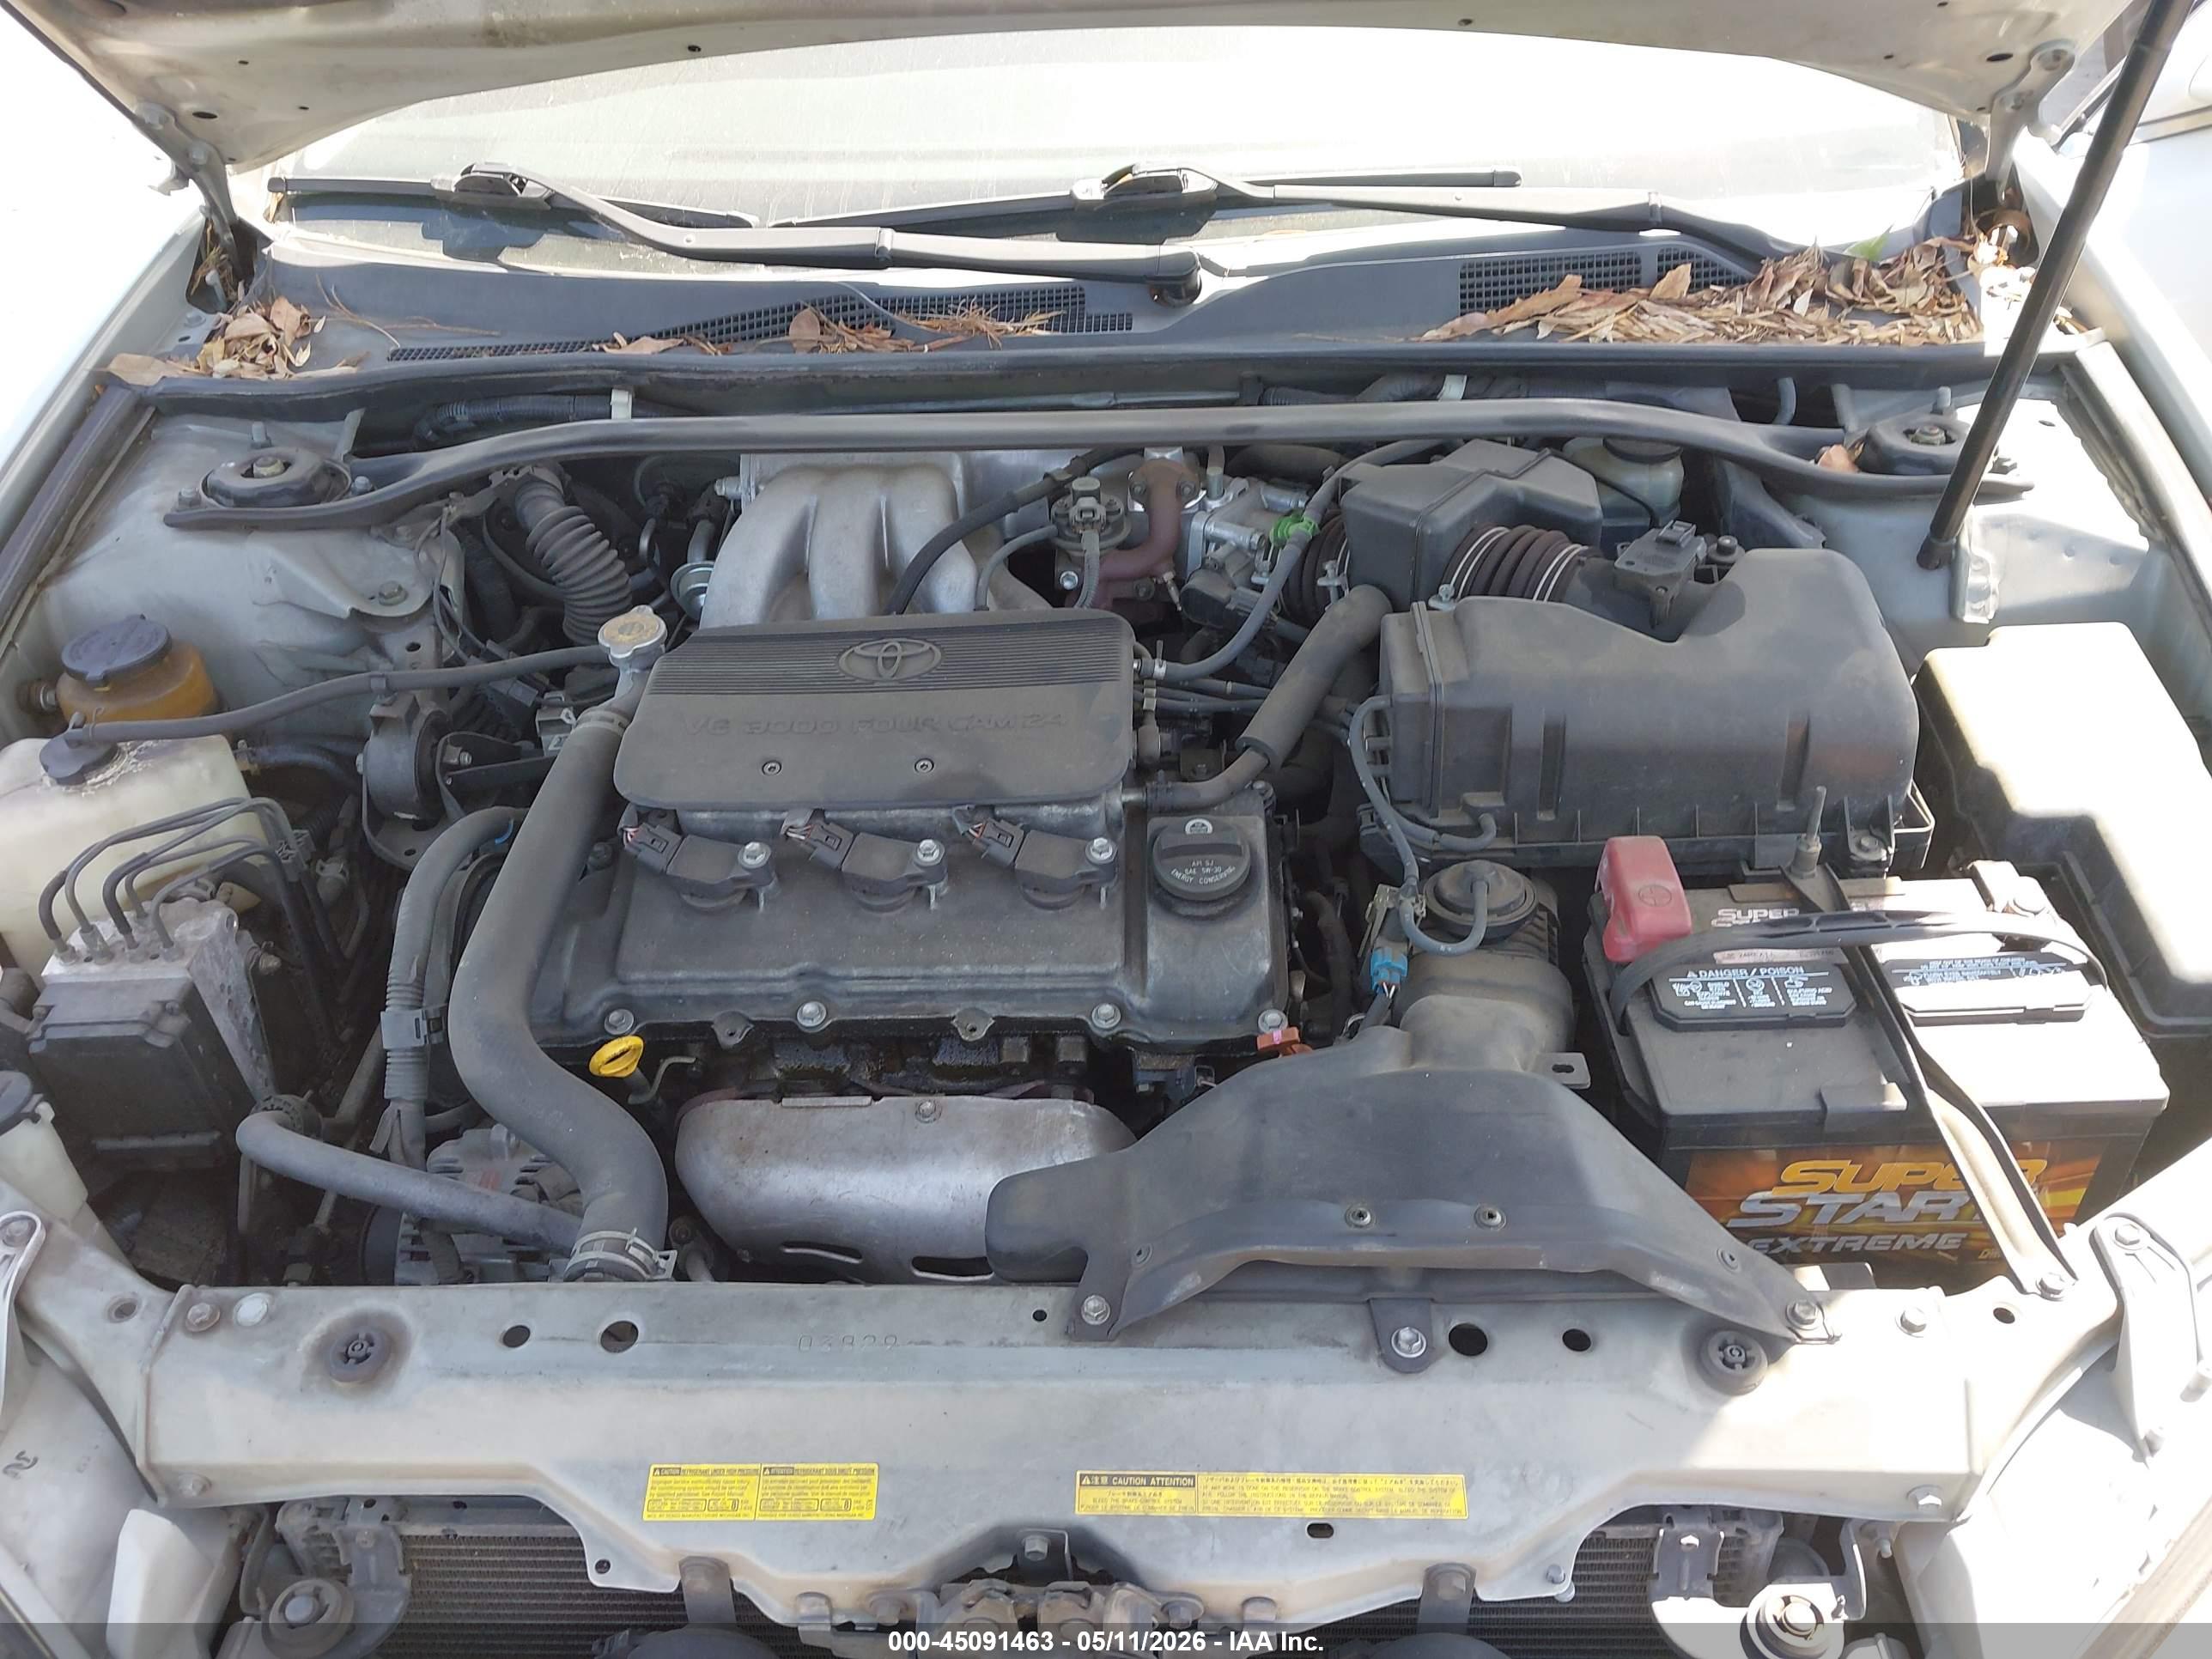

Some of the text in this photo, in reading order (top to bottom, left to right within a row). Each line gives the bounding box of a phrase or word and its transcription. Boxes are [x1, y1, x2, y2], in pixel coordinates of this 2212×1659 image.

[1170, 868, 1194, 883] ENERGY
[1699, 968, 1748, 978] DANGER
[1759, 966, 1804, 976] POISON
[1727, 1190, 1982, 1228] STAR
[1747, 1232, 1968, 1254] EXTREME
[1112, 1476, 1146, 1486] CAUTION
[1150, 1476, 1194, 1486] ATTENTION
